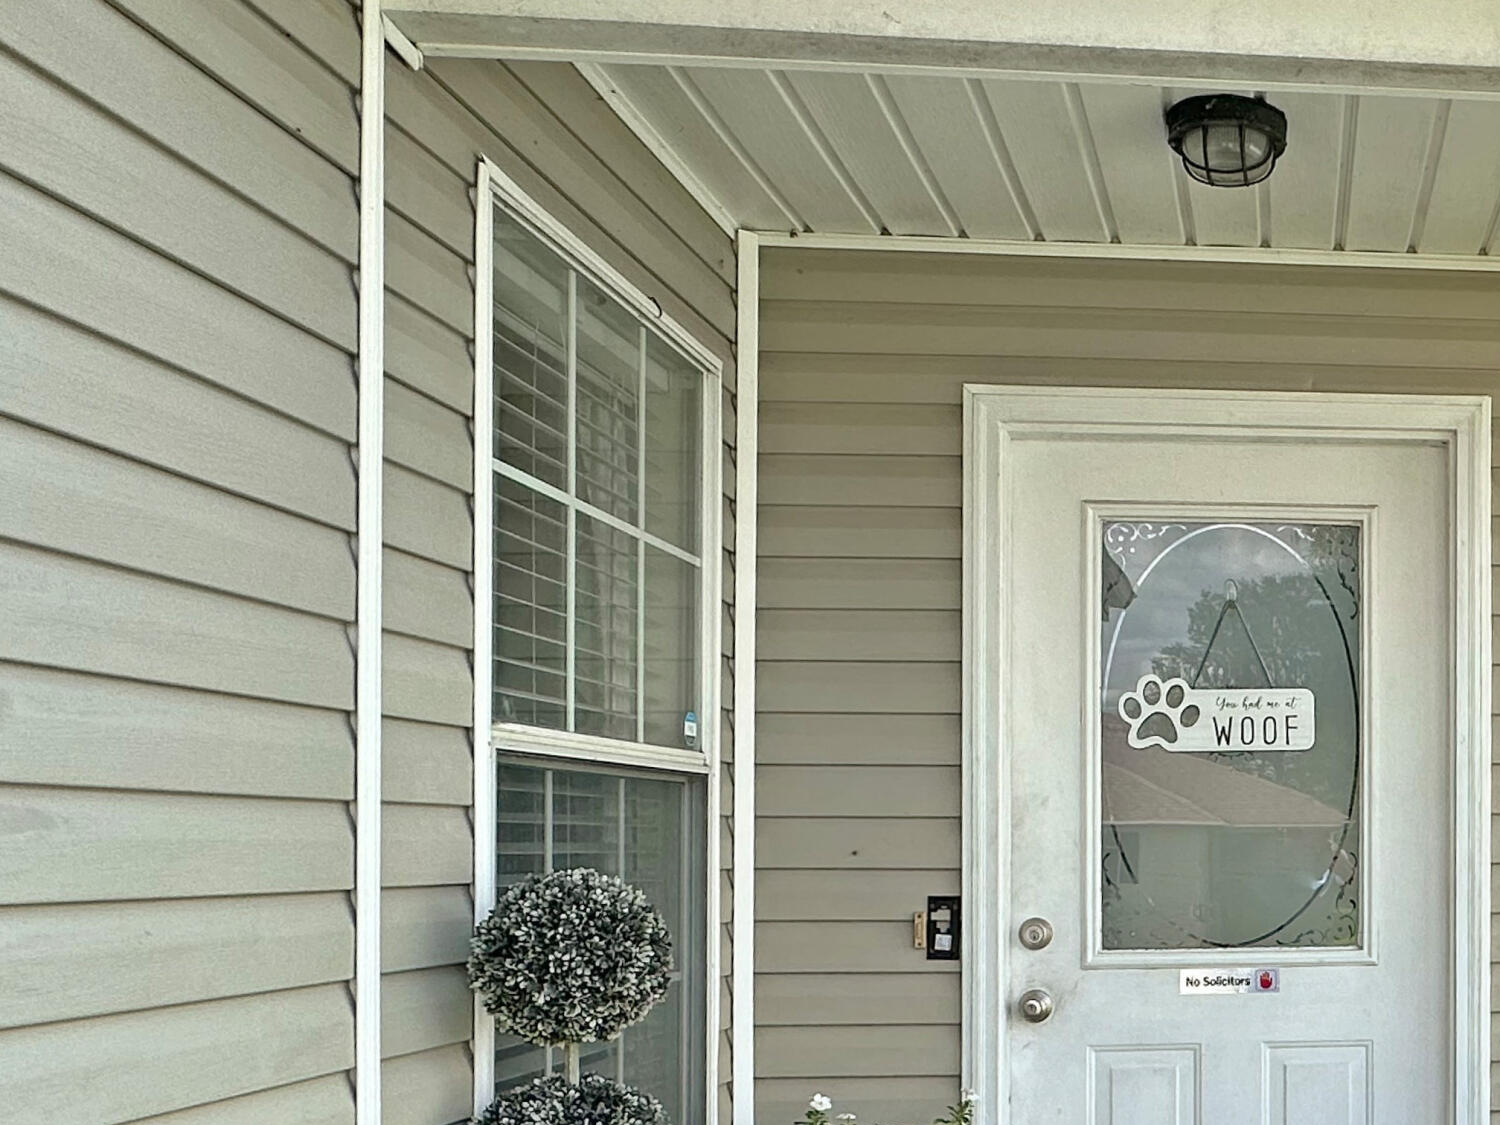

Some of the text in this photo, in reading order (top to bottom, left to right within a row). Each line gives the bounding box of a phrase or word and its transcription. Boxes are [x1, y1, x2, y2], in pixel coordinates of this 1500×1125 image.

[1216, 696, 1238, 711] You
[1242, 696, 1262, 710] had
[1285, 696, 1301, 709] at
[1212, 715, 1298, 746] WOOF
[1185, 975, 1251, 987] No Solicitors
